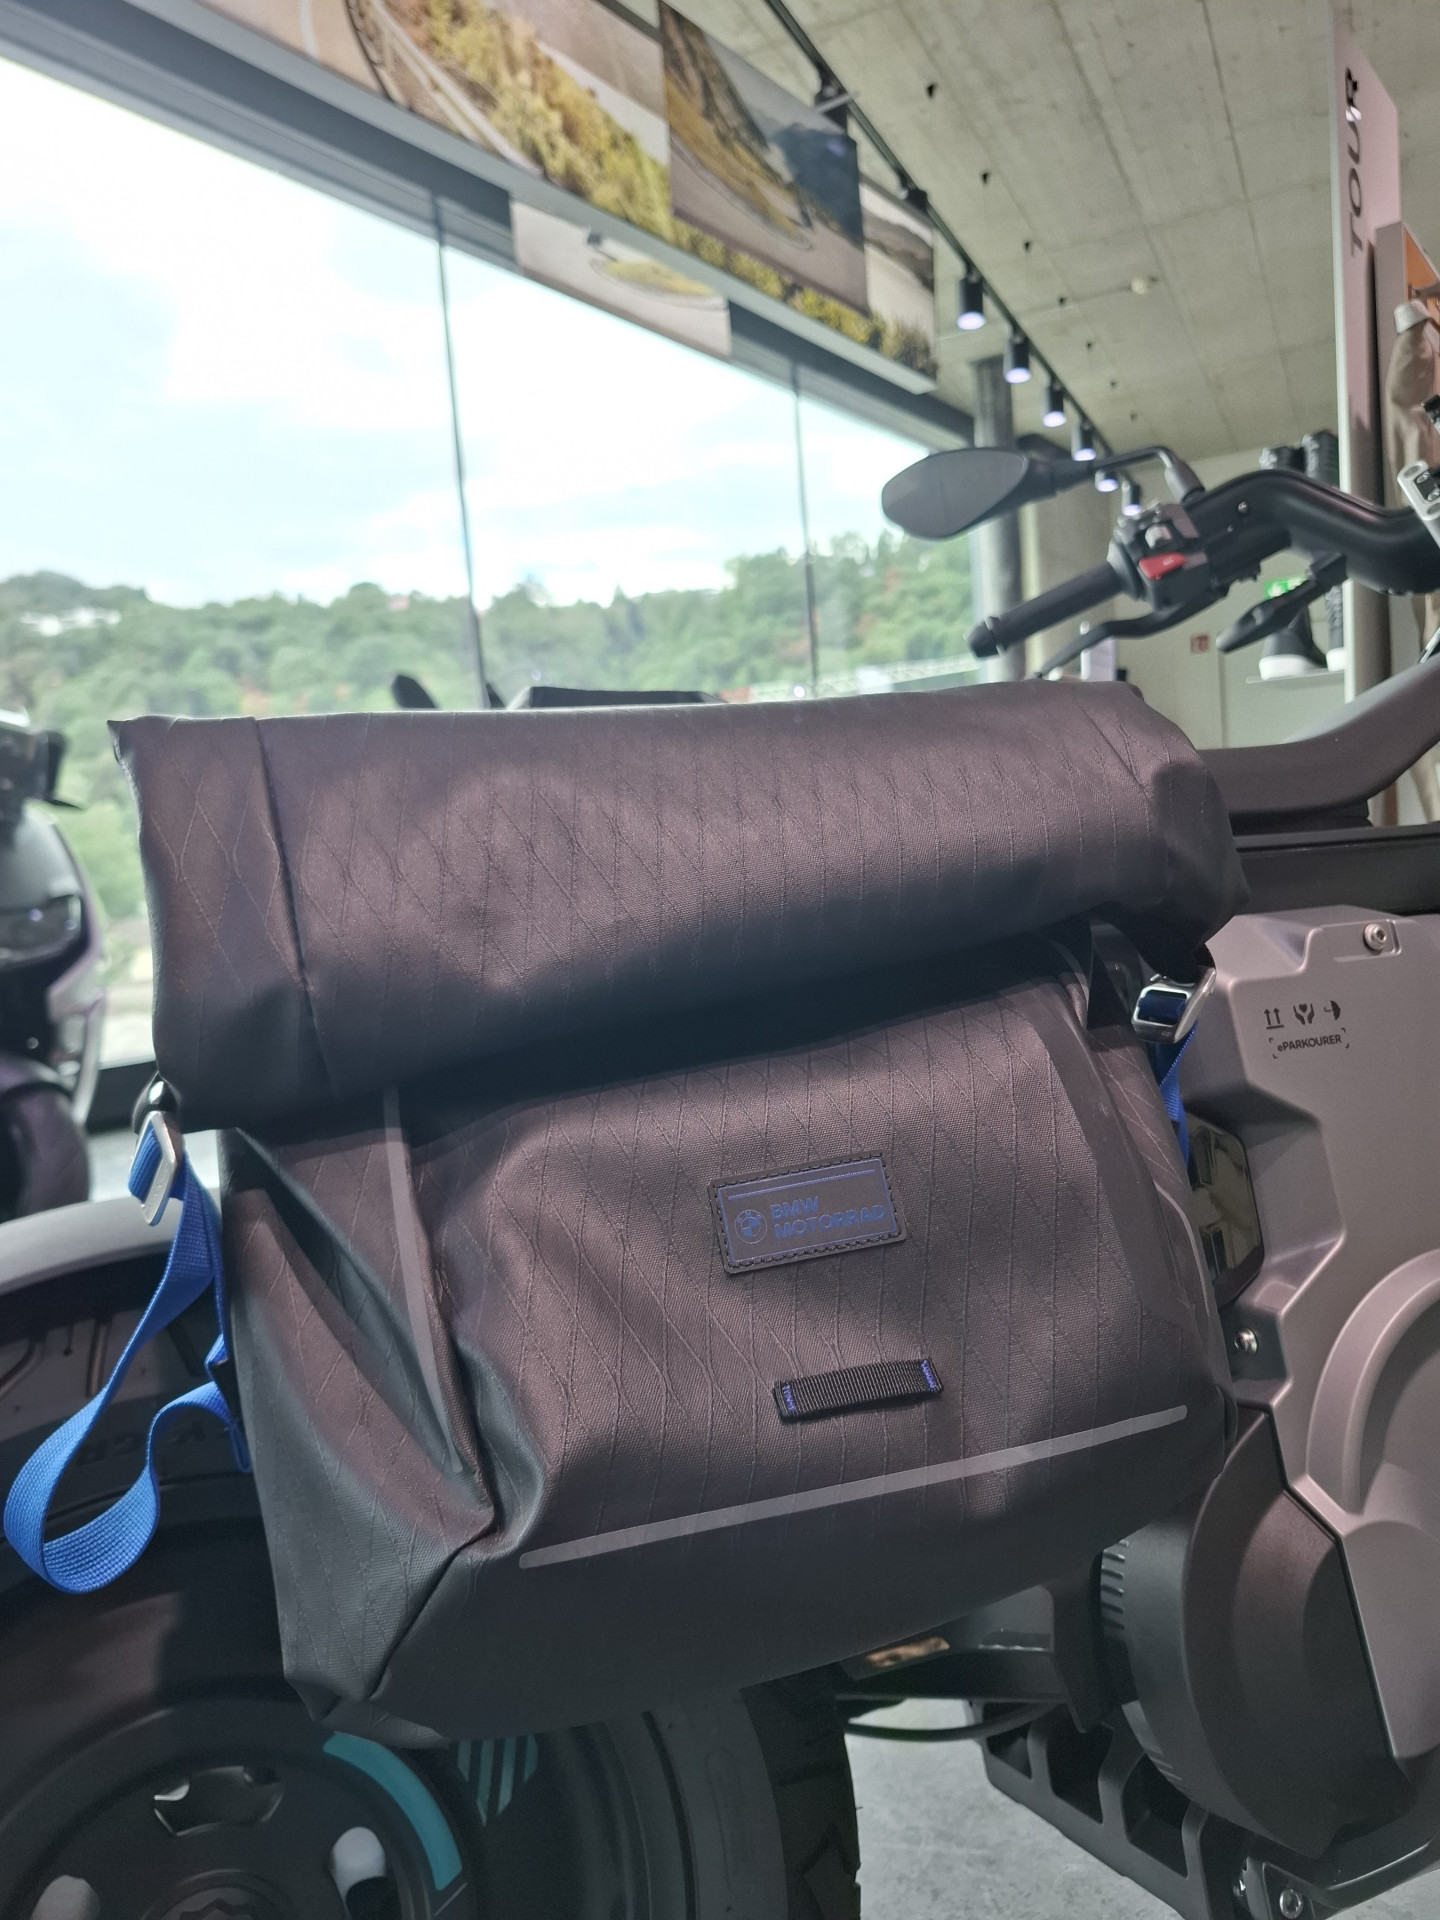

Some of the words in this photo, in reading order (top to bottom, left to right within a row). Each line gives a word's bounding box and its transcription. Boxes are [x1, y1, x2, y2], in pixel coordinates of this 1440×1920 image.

[1345, 67, 1362, 257] TOUR
[1277, 1034, 1342, 1052] ePARKOURER
[770, 1196, 819, 1221] BMW
[774, 1205, 886, 1240] MOTORRAD
